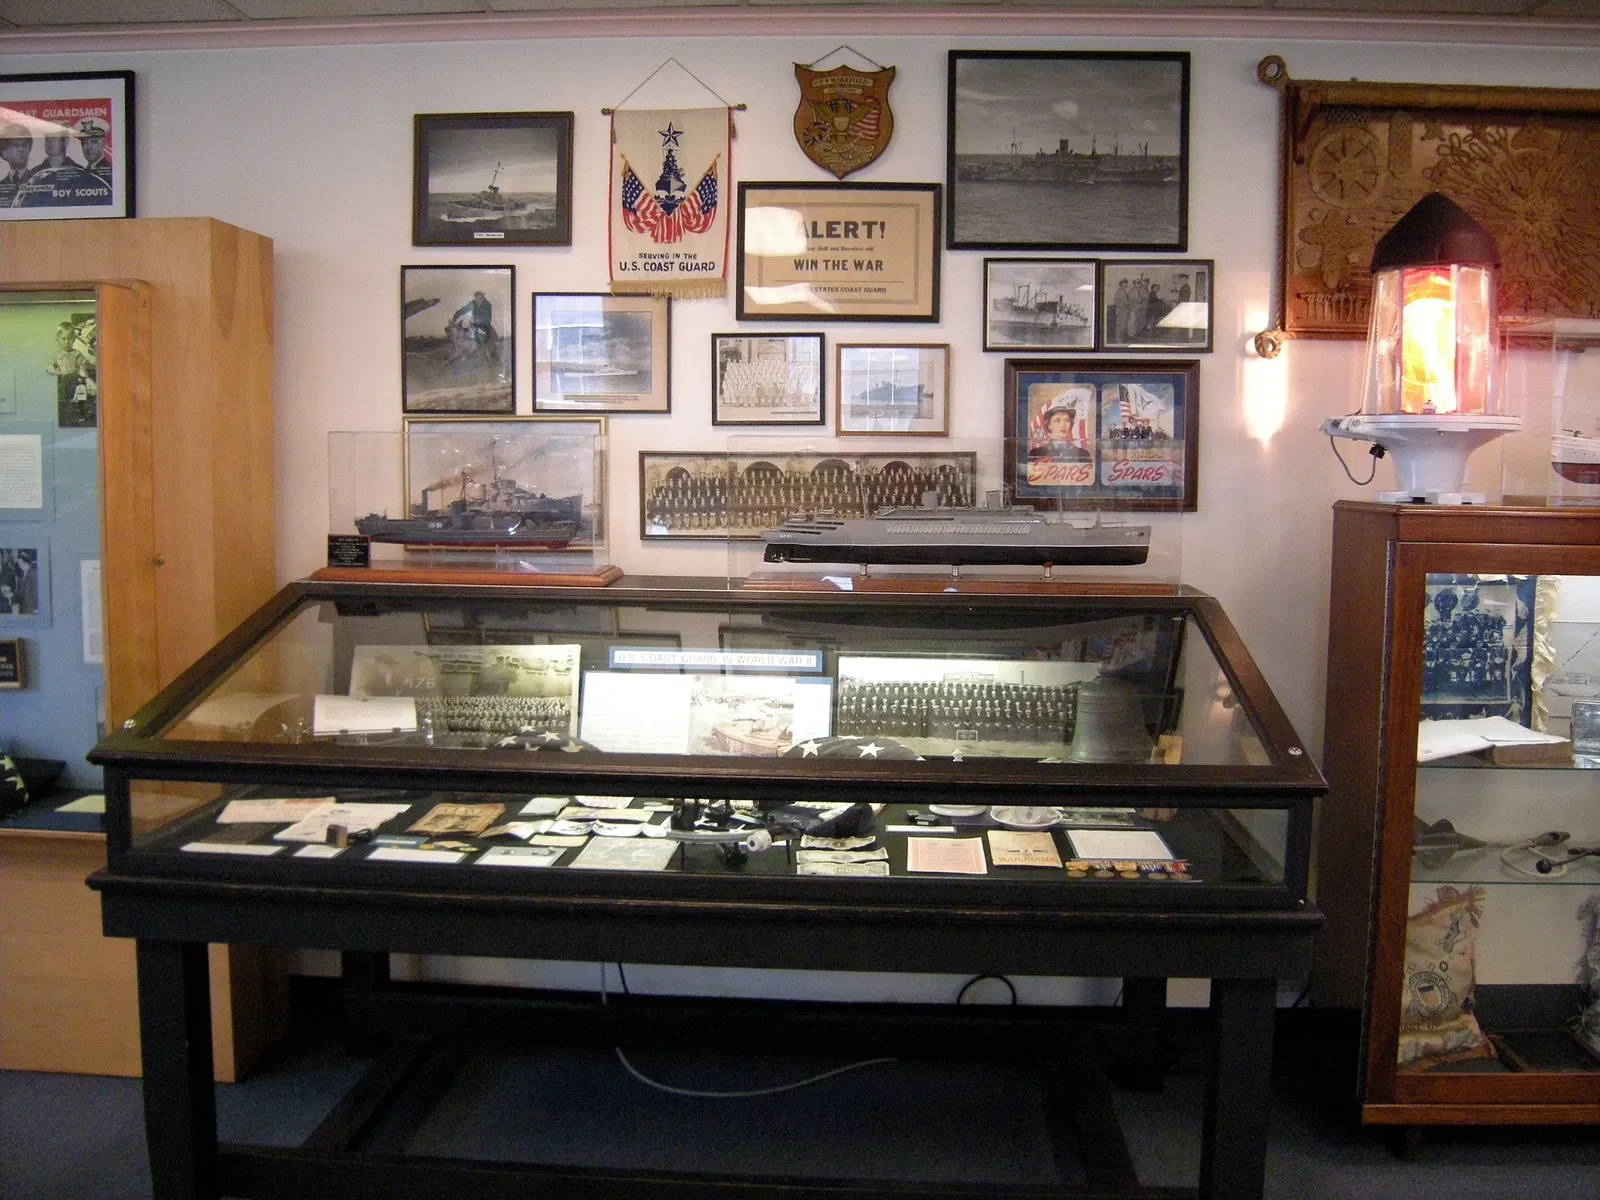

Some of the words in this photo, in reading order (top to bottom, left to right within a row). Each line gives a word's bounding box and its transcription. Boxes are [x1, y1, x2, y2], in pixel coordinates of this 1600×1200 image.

[43, 107, 107, 118] GUARDSMEN
[52, 189, 72, 198] BOY
[75, 187, 108, 197] SCOUTS
[639, 252, 670, 260] SERVING
[673, 252, 681, 260] IN
[684, 252, 698, 260] THE
[619, 261, 641, 272] U.S.
[643, 261, 676, 272] COAST
[678, 261, 716, 272] GUARD
[793, 258, 819, 272] WIN
[822, 258, 849, 272] THE
[853, 258, 884, 272] WAR
[863, 286, 887, 294] GUARD
[641, 653, 677, 663] COAST
[681, 654, 717, 664] GUARD
[722, 655, 733, 664] IN
[737, 655, 775, 665] WORLD
[779, 656, 803, 666] WAR
[806, 656, 813, 666] II
